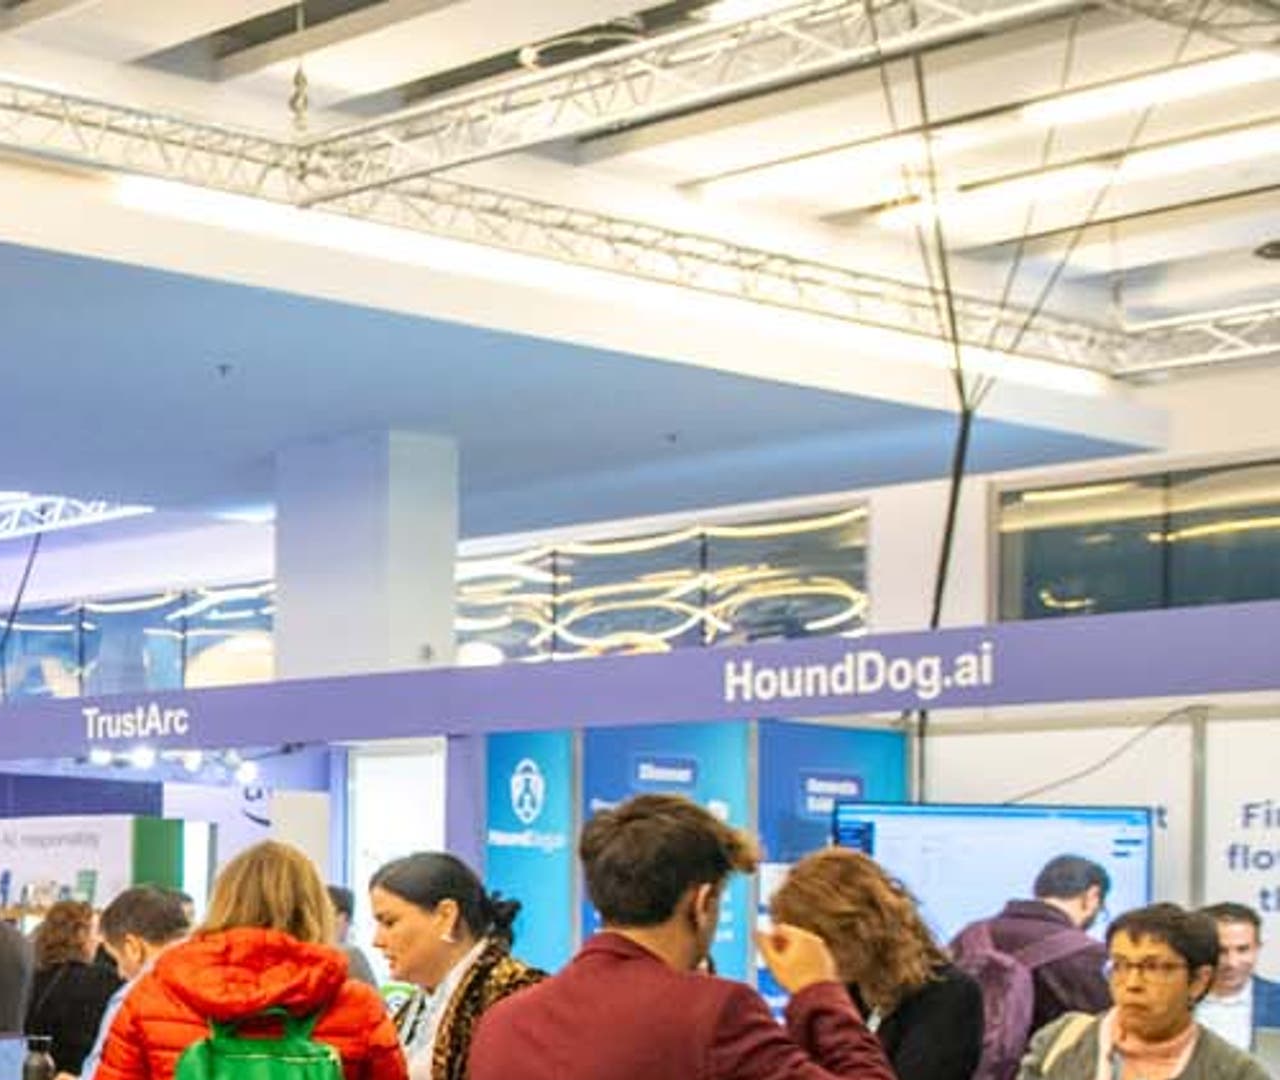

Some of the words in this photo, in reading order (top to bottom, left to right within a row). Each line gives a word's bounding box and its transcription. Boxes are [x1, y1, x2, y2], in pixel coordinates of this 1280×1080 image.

[724, 641, 993, 702] HoundDog.ai
[81, 702, 189, 738] TrustArc
[1243, 800, 1280, 829] Fi
[1227, 844, 1280, 870] flo
